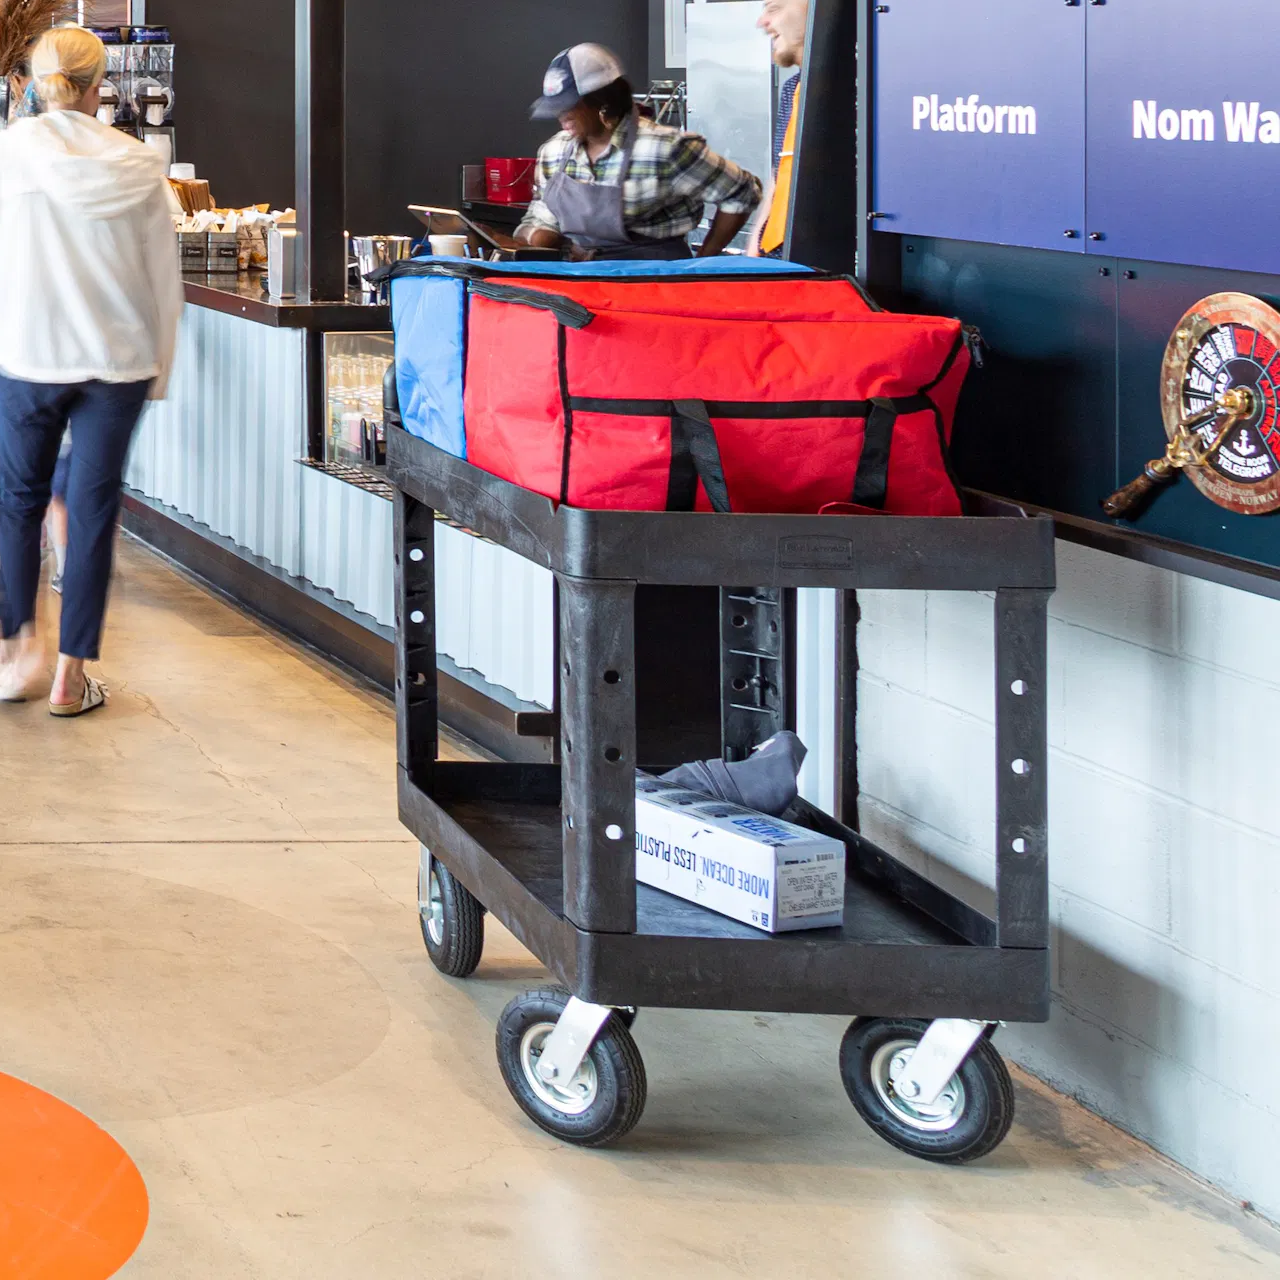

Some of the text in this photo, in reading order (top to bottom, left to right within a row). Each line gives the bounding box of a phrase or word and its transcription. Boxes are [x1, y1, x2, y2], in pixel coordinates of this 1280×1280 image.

[913, 94, 1037, 135] Platform
[1133, 100, 1215, 141] Nom
[1217, 453, 1272, 479] TELEGRAPH
[673, 846, 696, 871] LESS
[739, 870, 770, 900] MORE
